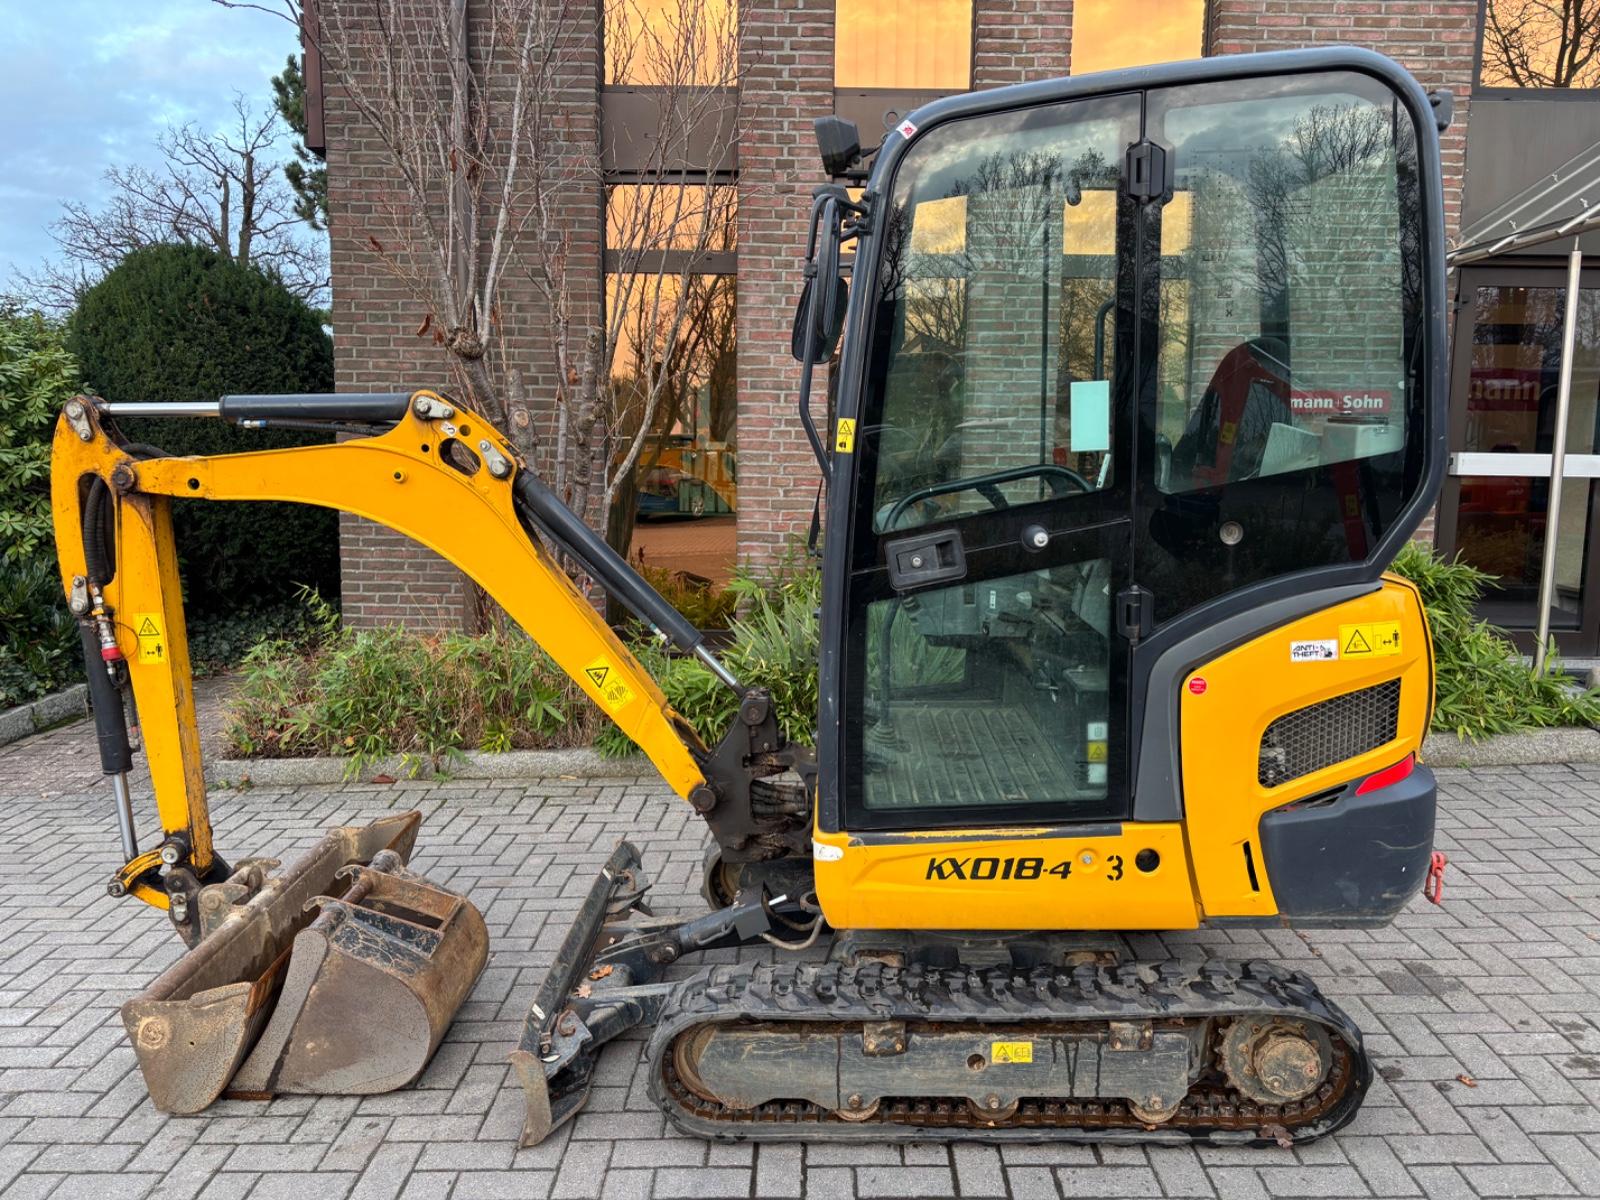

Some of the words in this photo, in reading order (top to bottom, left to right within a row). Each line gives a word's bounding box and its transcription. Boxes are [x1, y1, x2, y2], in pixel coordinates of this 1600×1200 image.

[1290, 398, 1333, 409] mann
[1343, 394, 1384, 409] Sohn
[925, 857, 1072, 880] KX018-4
[1106, 855, 1123, 881] 3
